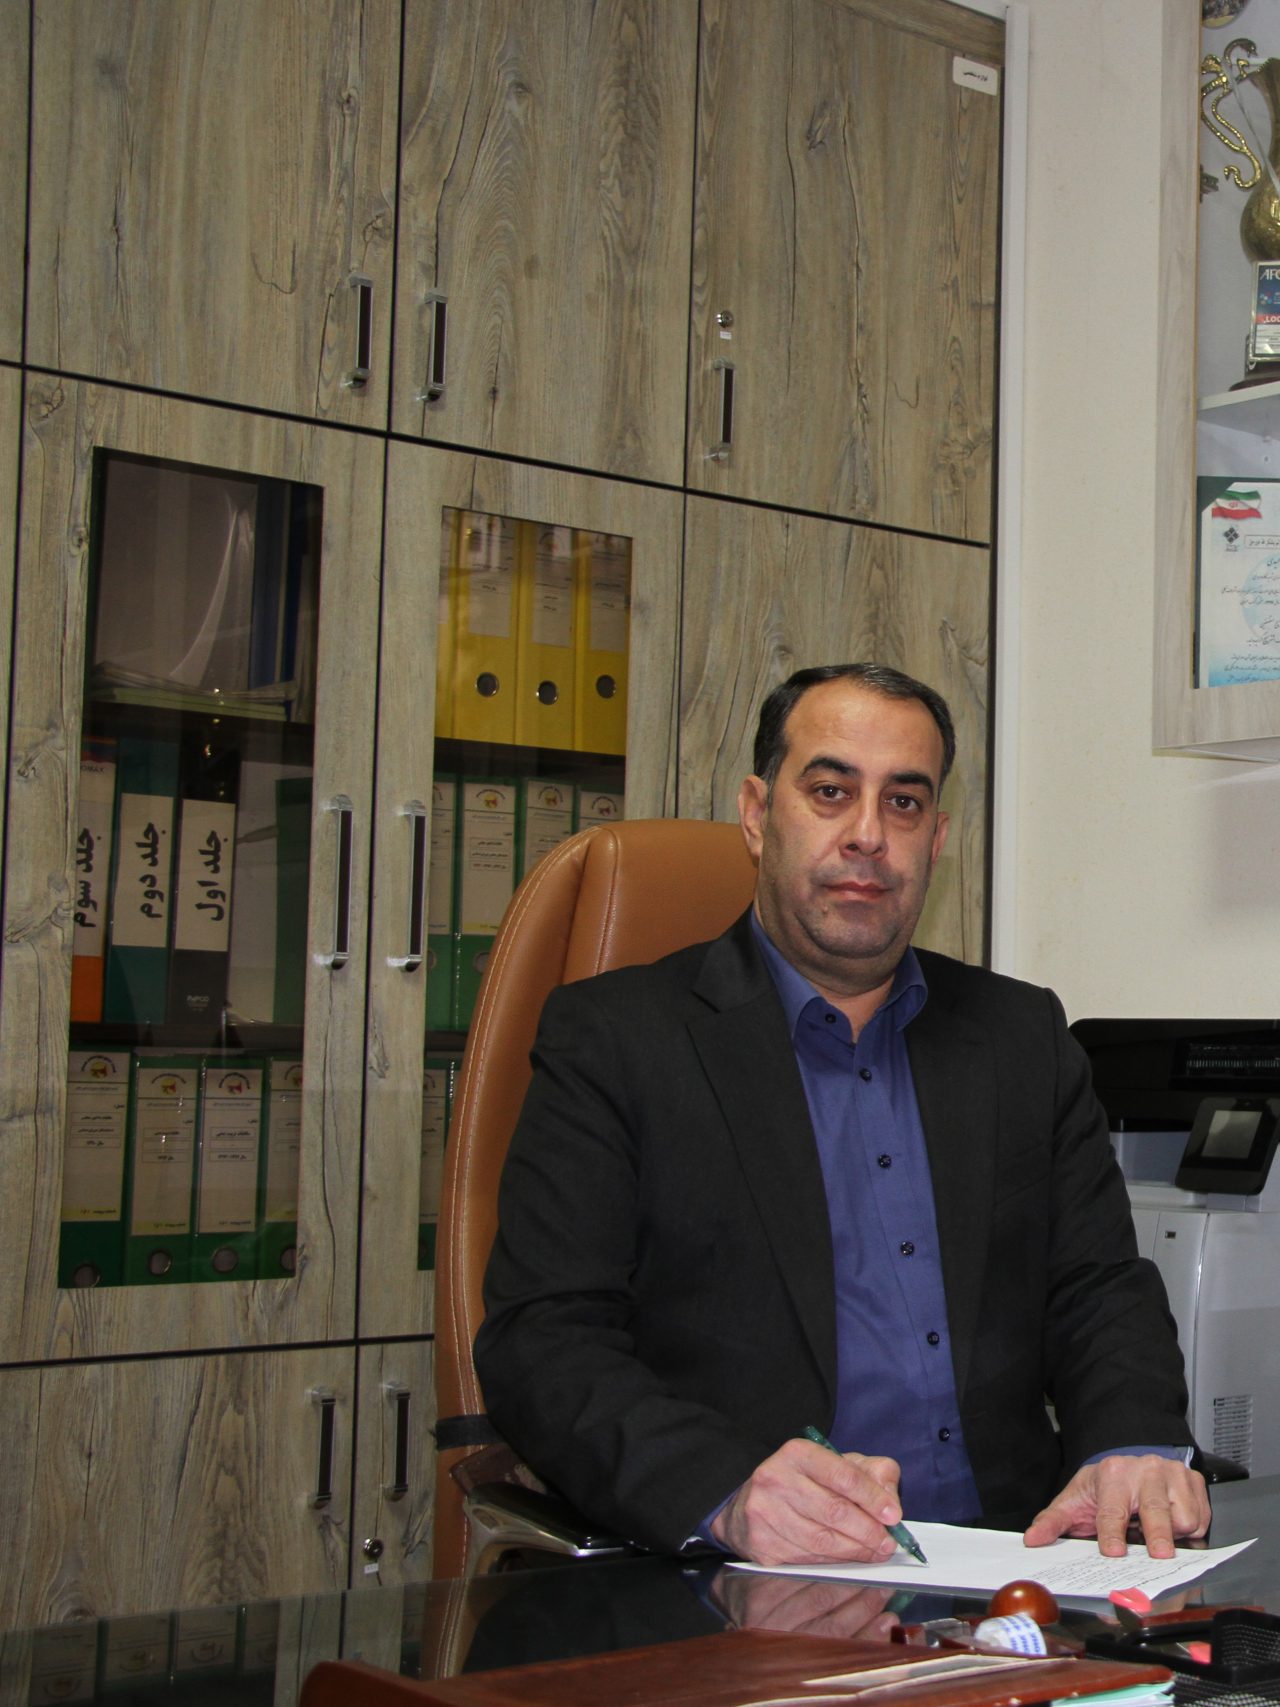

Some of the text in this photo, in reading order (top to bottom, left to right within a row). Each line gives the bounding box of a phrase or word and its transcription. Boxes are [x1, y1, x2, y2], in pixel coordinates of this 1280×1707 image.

[73, 827, 103, 928] جلد سوم
[135, 821, 167, 919] جلد دوم
[194, 829, 229, 922] جلد اول
